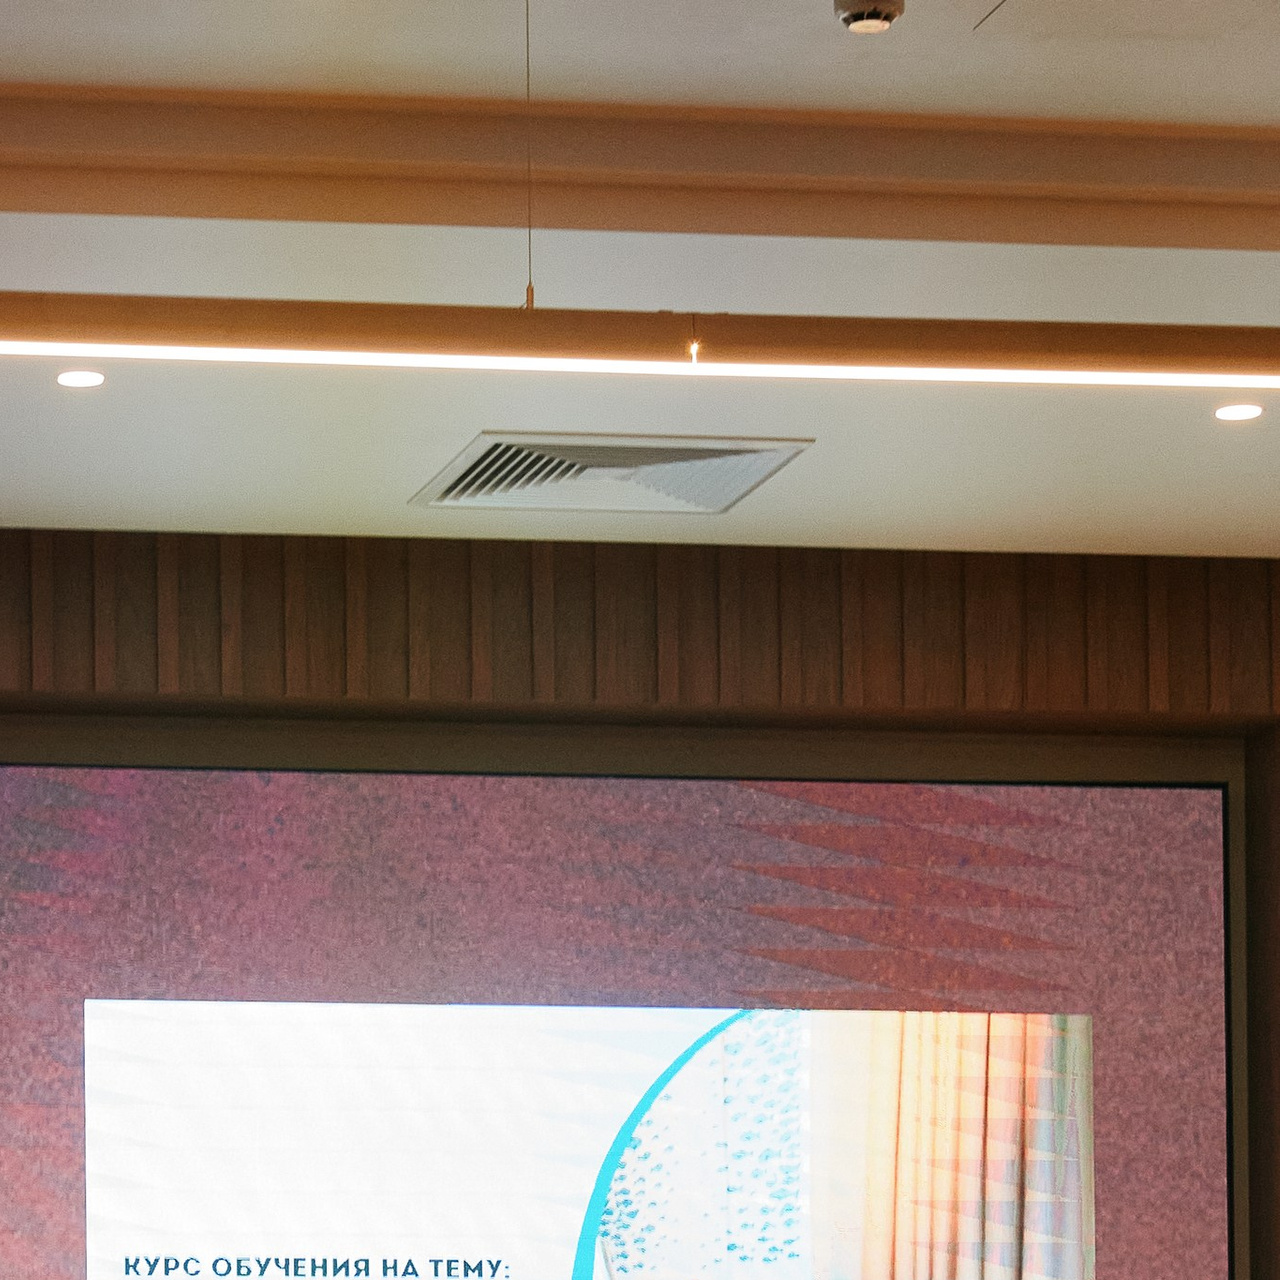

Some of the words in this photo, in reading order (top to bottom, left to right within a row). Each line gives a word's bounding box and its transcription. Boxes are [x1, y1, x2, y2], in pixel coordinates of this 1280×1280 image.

[123, 1255, 201, 1278] КУРС
[211, 1256, 371, 1279] ОБУЧЕНИЯ
[381, 1257, 420, 1280] НА
[428, 1257, 512, 1280] ТЕМУ:
